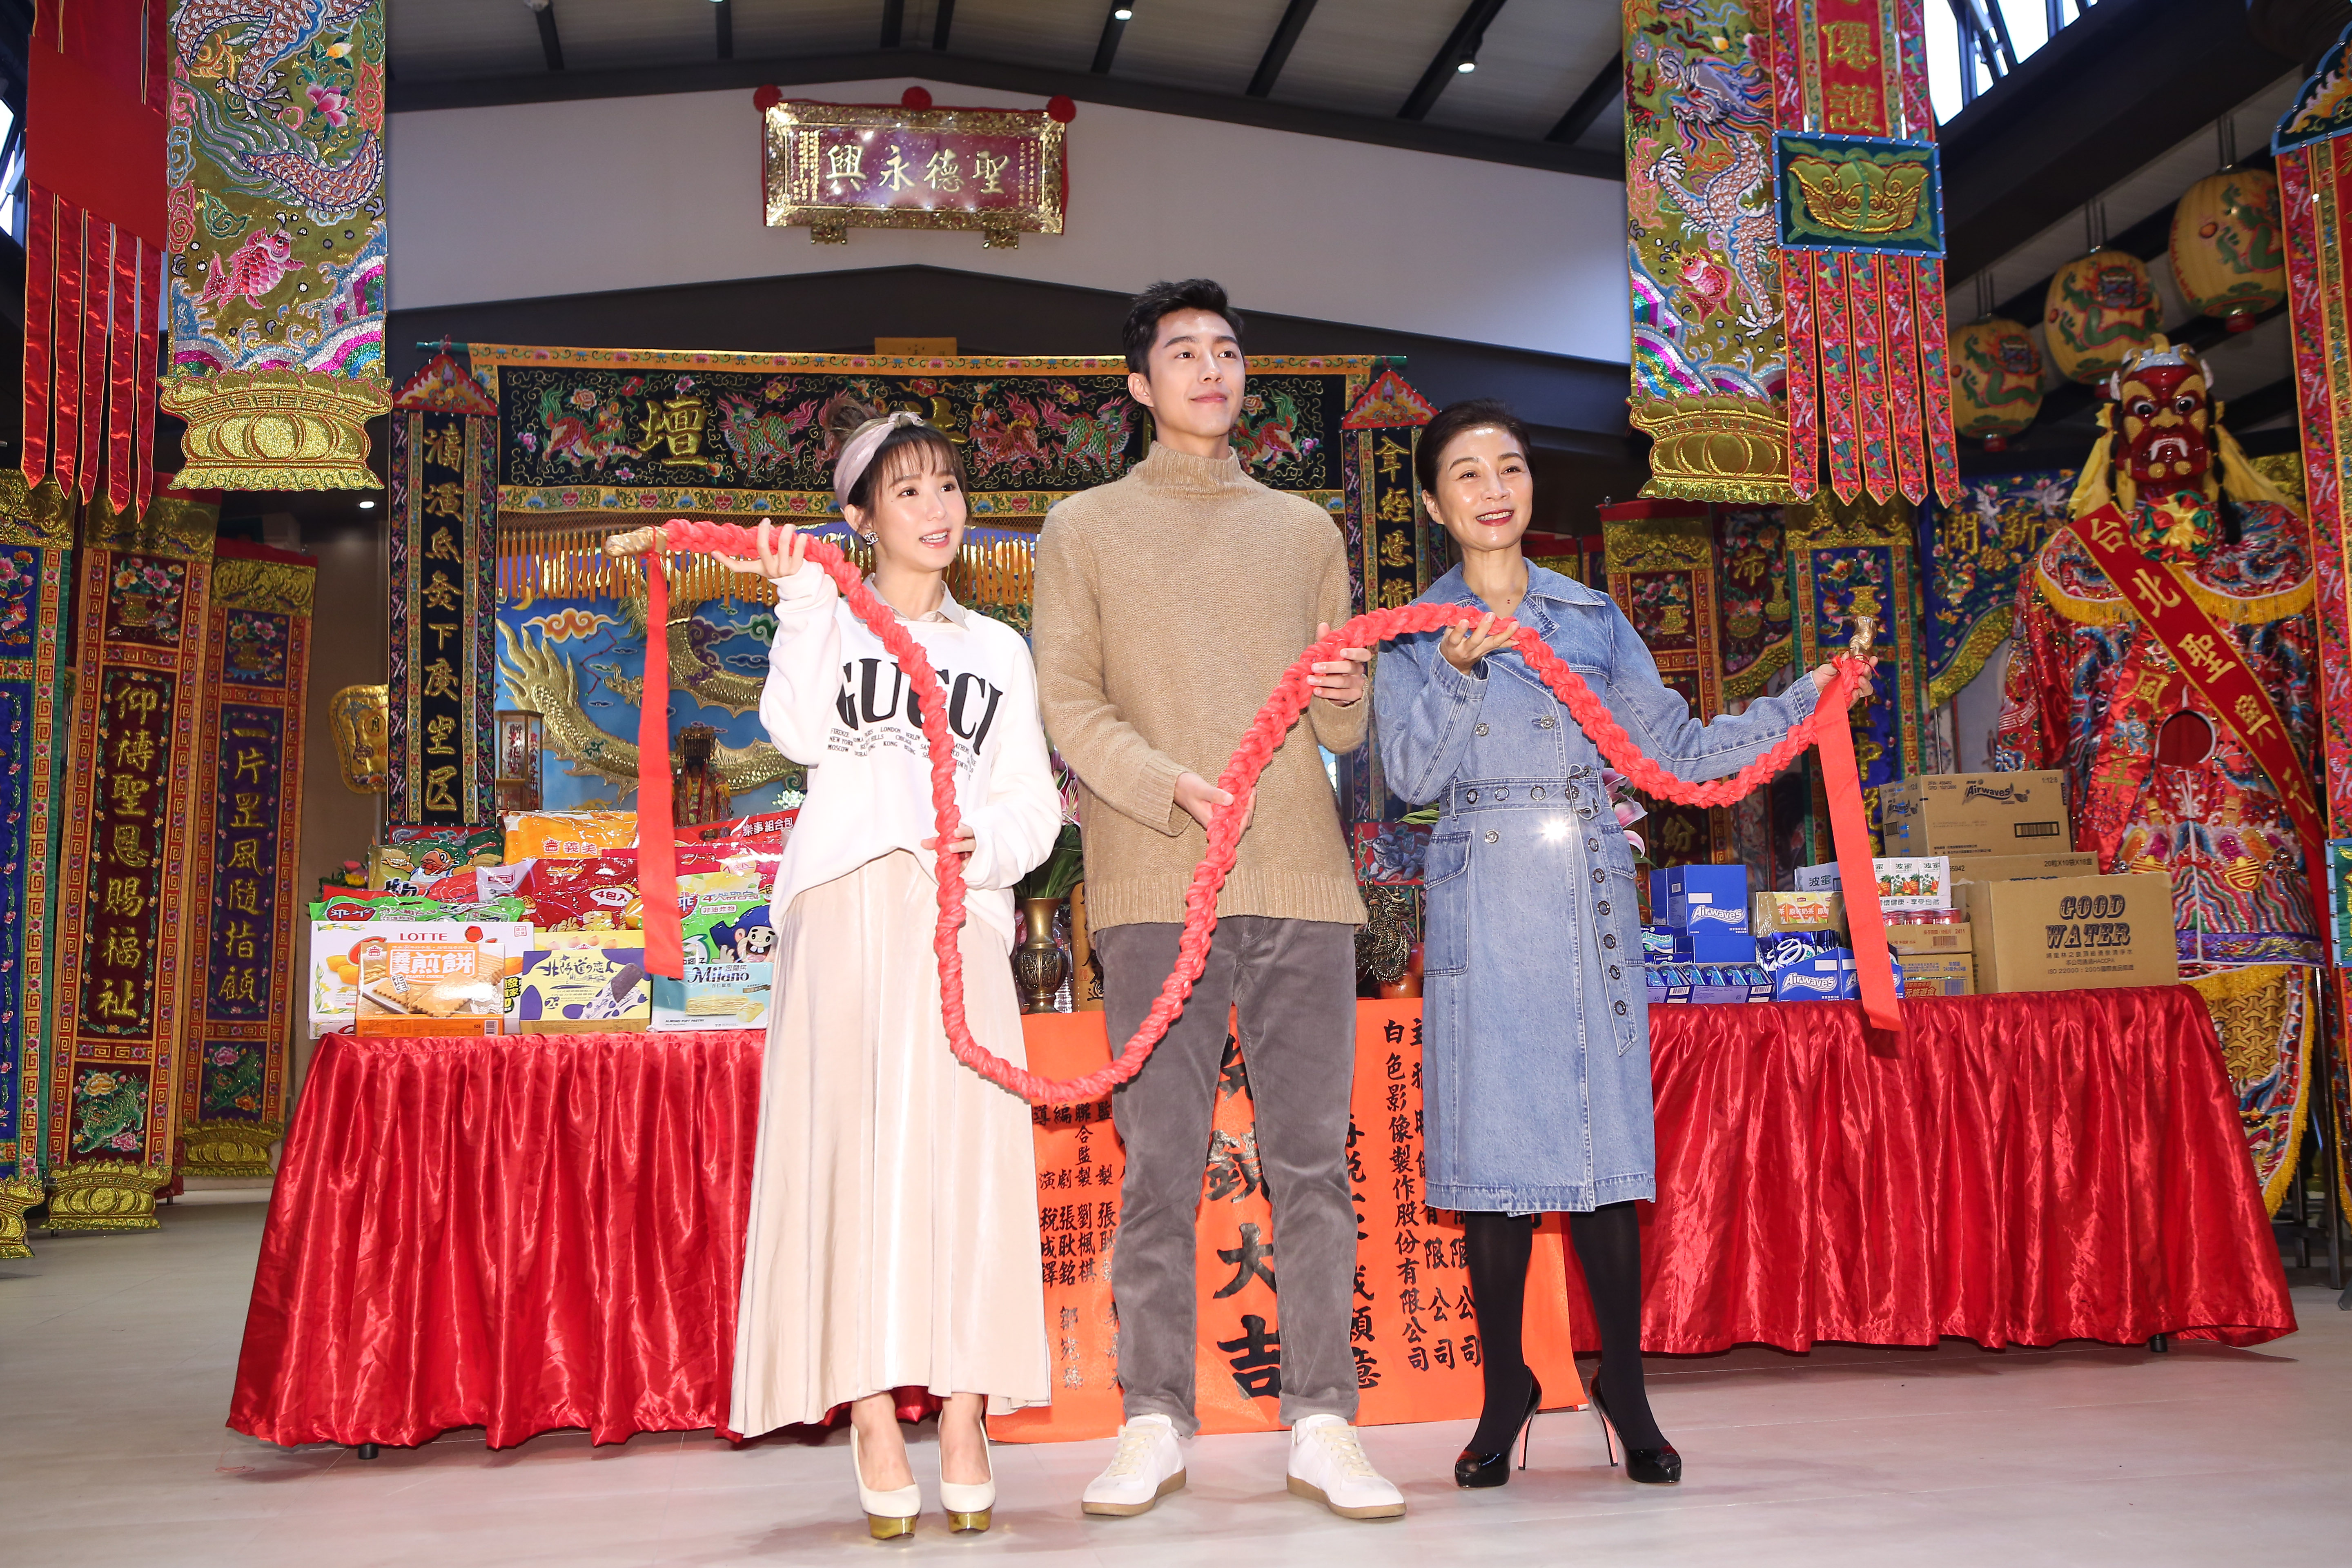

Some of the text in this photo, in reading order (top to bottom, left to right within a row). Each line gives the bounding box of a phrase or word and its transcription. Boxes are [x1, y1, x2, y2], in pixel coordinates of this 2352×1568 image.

[831, 728, 849, 737] FIRENZE
[905, 732, 920, 741] BERLIN
[827, 744, 849, 753] MOSCOW
[1966, 785, 2013, 798] Airwaves
[563, 841, 597, 855] 義美
[1809, 875, 1831, 887] 波蜜
[702, 904, 736, 913] 非油炸物
[1691, 904, 1744, 921] Airwaves
[2059, 894, 2126, 920] GOOD
[1642, 932, 1670, 941] Airwaves
[2045, 922, 2131, 949] WATER
[410, 952, 472, 974] 煎餅
[687, 966, 750, 983] Milano
[1783, 973, 1836, 989] Airwaves
[393, 976, 408, 993] 花生
[1033, 1104, 1056, 1190] 導演
[1074, 1102, 1094, 1187] 聯合監製
[1095, 1100, 1117, 1186] 監製
